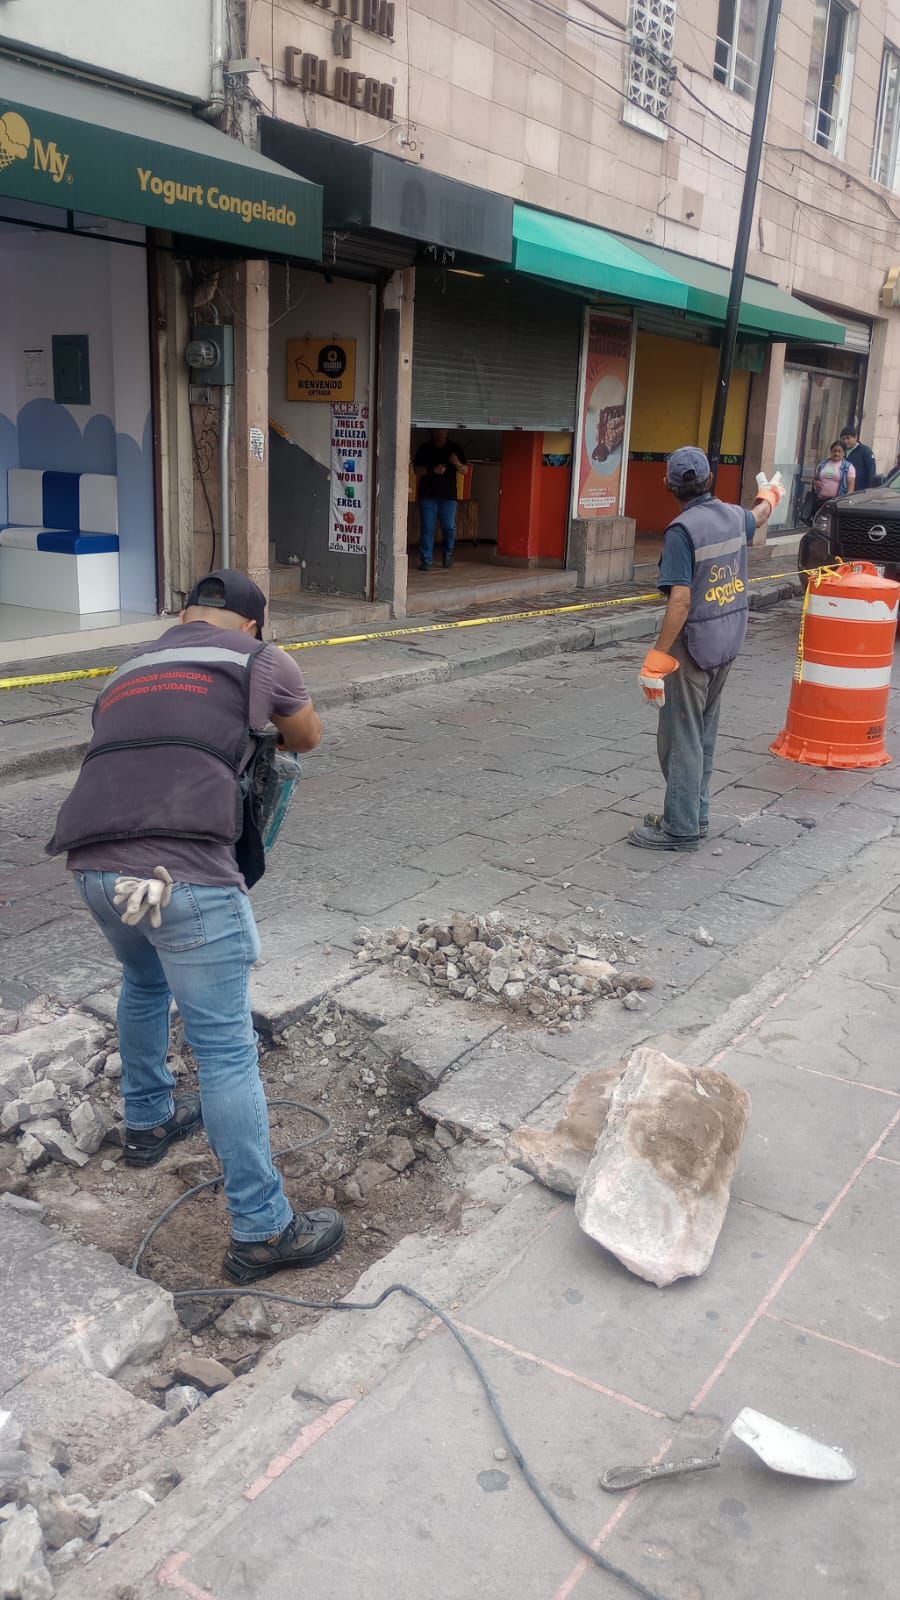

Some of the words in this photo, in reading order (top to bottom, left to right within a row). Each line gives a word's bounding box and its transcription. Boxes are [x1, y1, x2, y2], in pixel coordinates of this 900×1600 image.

[285, 46, 394, 120] CALDERA
[137, 167, 203, 205] Yogurt
[206, 187, 297, 227] Congelado
[297, 380, 343, 389] BIENVENIDO
[337, 420, 365, 429] INGLES
[335, 429, 366, 439] BELLEZA
[337, 448, 363, 457] PREPA
[336, 472, 363, 482] WORD
[336, 497, 362, 508] EXCEL
[334, 523, 363, 534] POWER
[336, 533, 361, 544] POINT
[347, 543, 368, 553] PISO
[159, 671, 214, 684] MUNICIPAL
